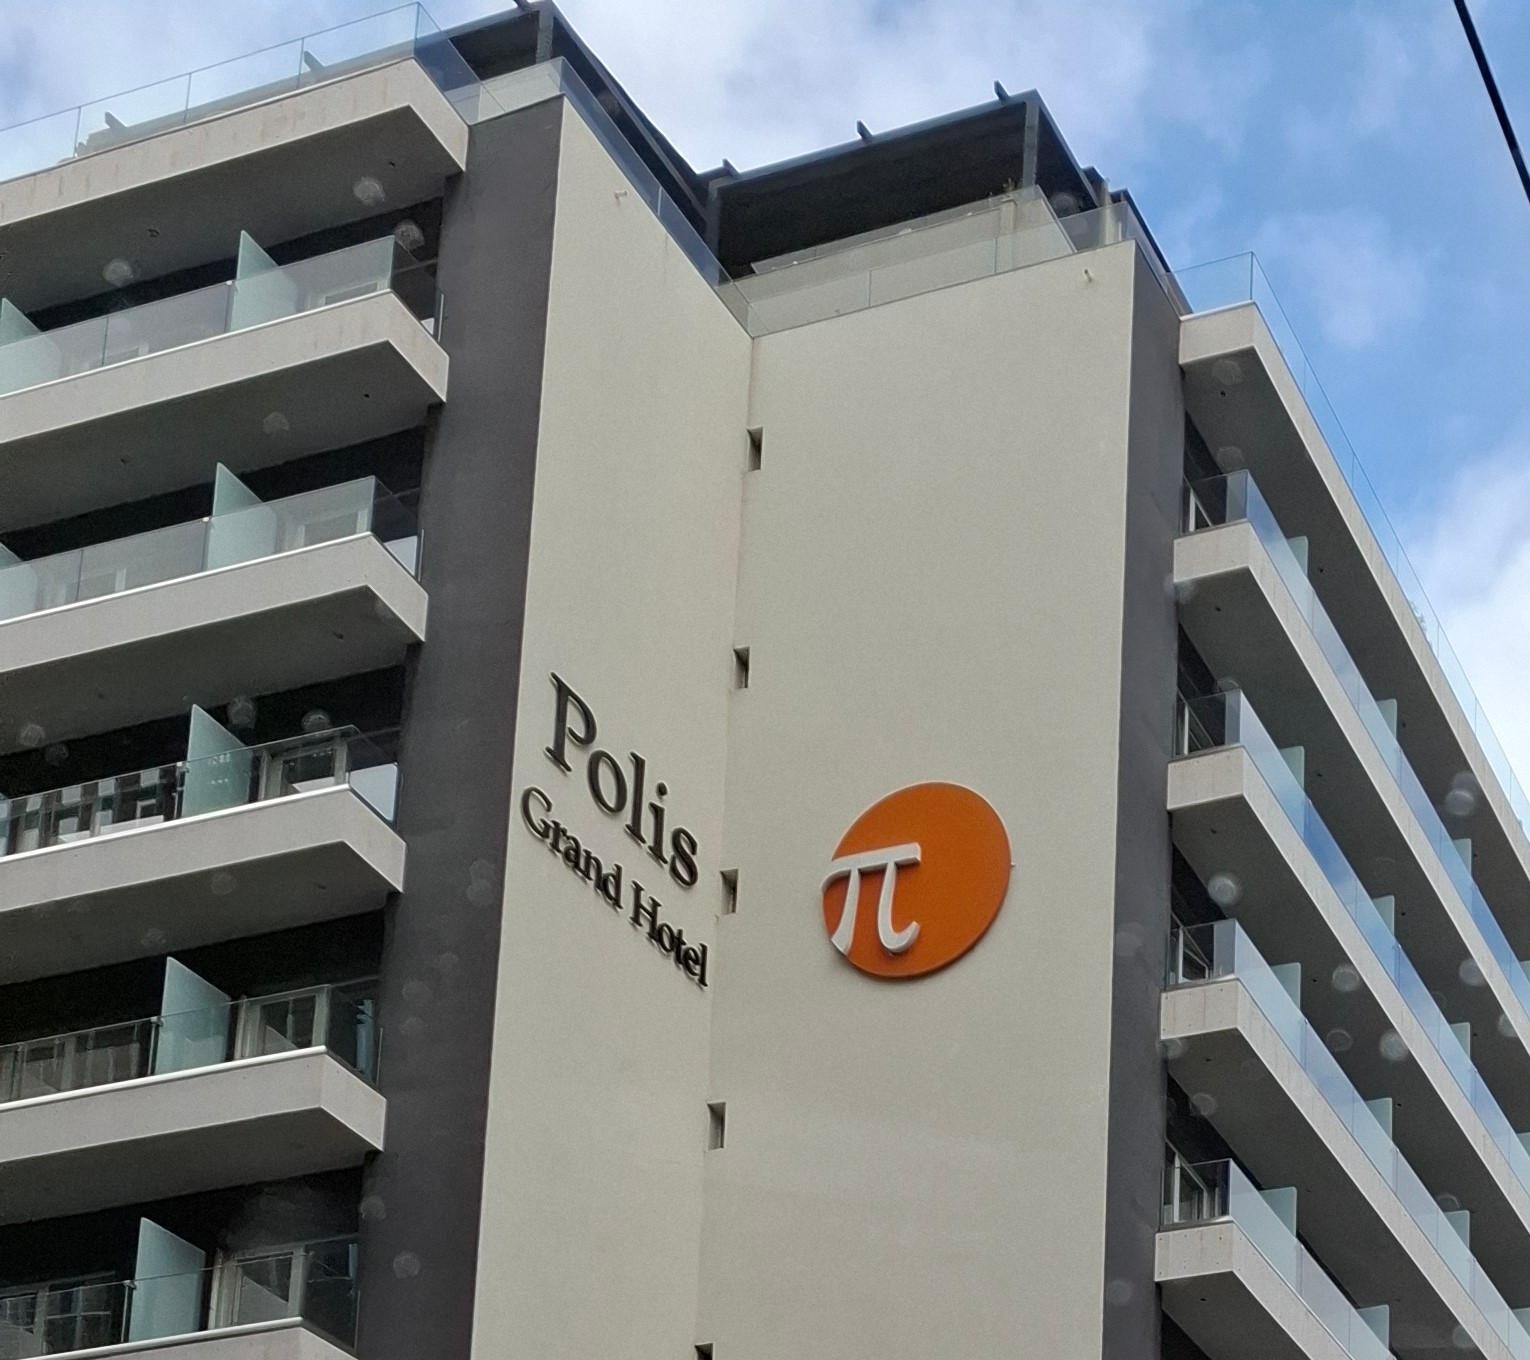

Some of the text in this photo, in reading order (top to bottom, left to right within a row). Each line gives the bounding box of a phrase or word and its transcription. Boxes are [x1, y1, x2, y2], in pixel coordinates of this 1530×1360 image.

[545, 671, 699, 887] Polis
[521, 786, 709, 987] Grand Hotel
